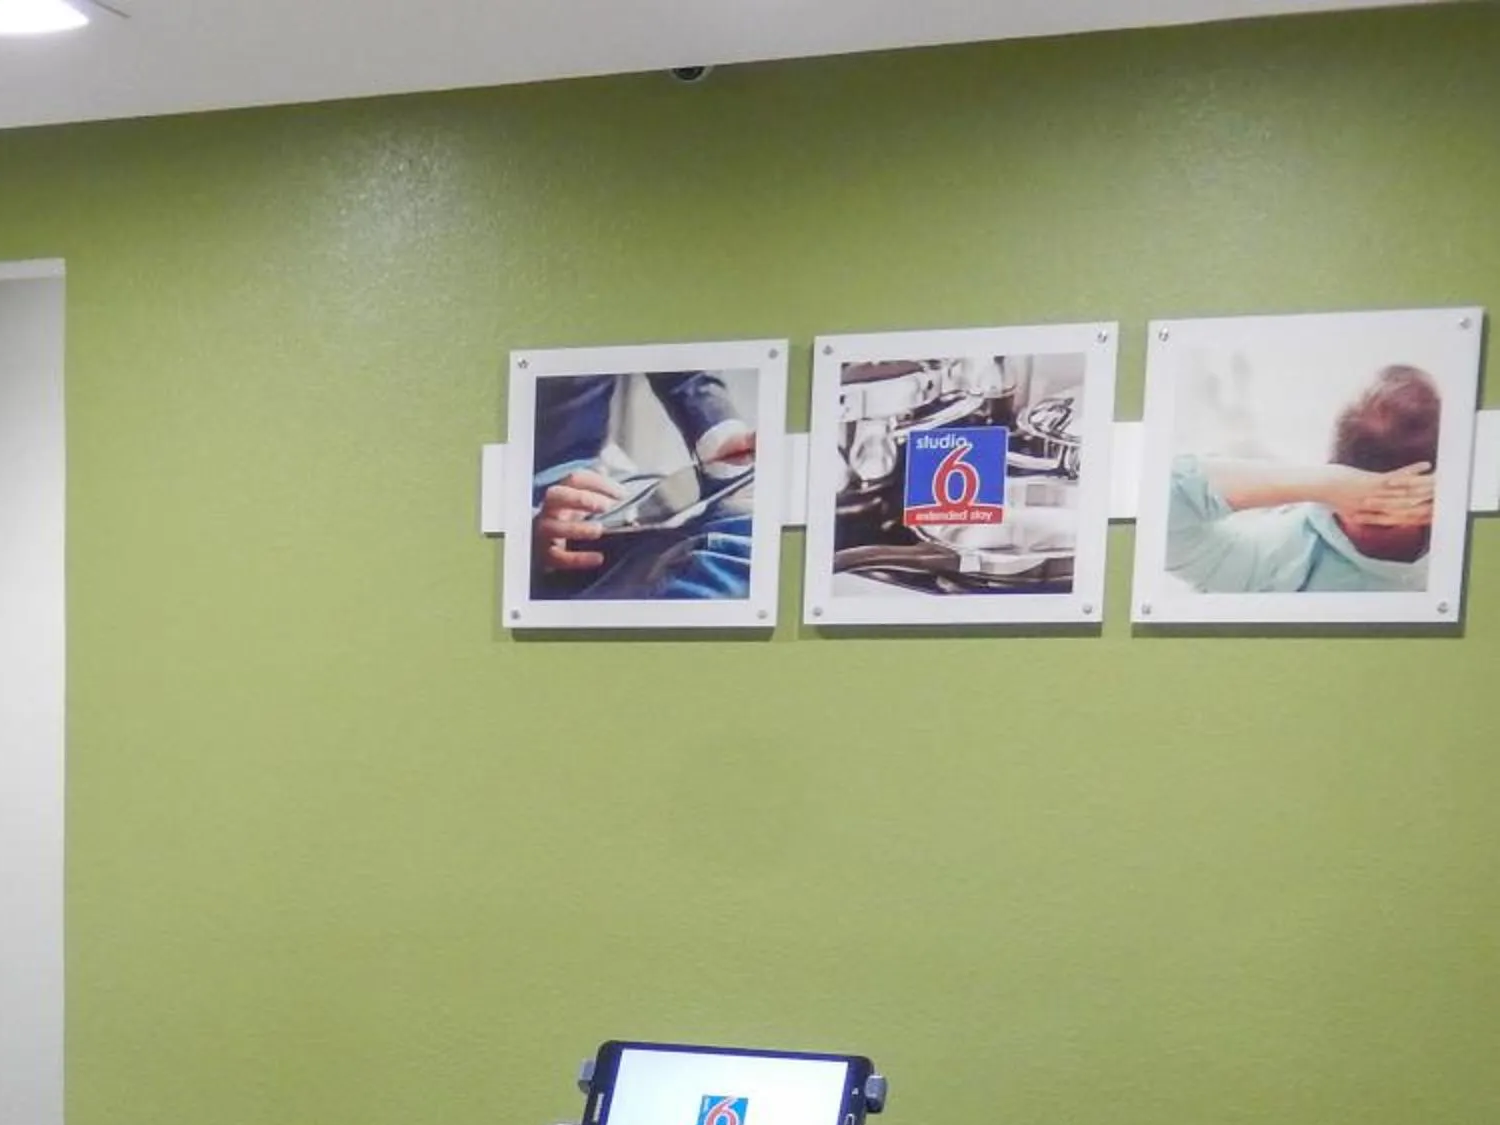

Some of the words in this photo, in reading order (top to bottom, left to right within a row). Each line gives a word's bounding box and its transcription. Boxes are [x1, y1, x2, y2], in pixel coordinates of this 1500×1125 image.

[915, 434, 967, 450] studio
[932, 443, 980, 505] 6
[915, 510, 967, 521] extended
[969, 510, 993, 521] stay
